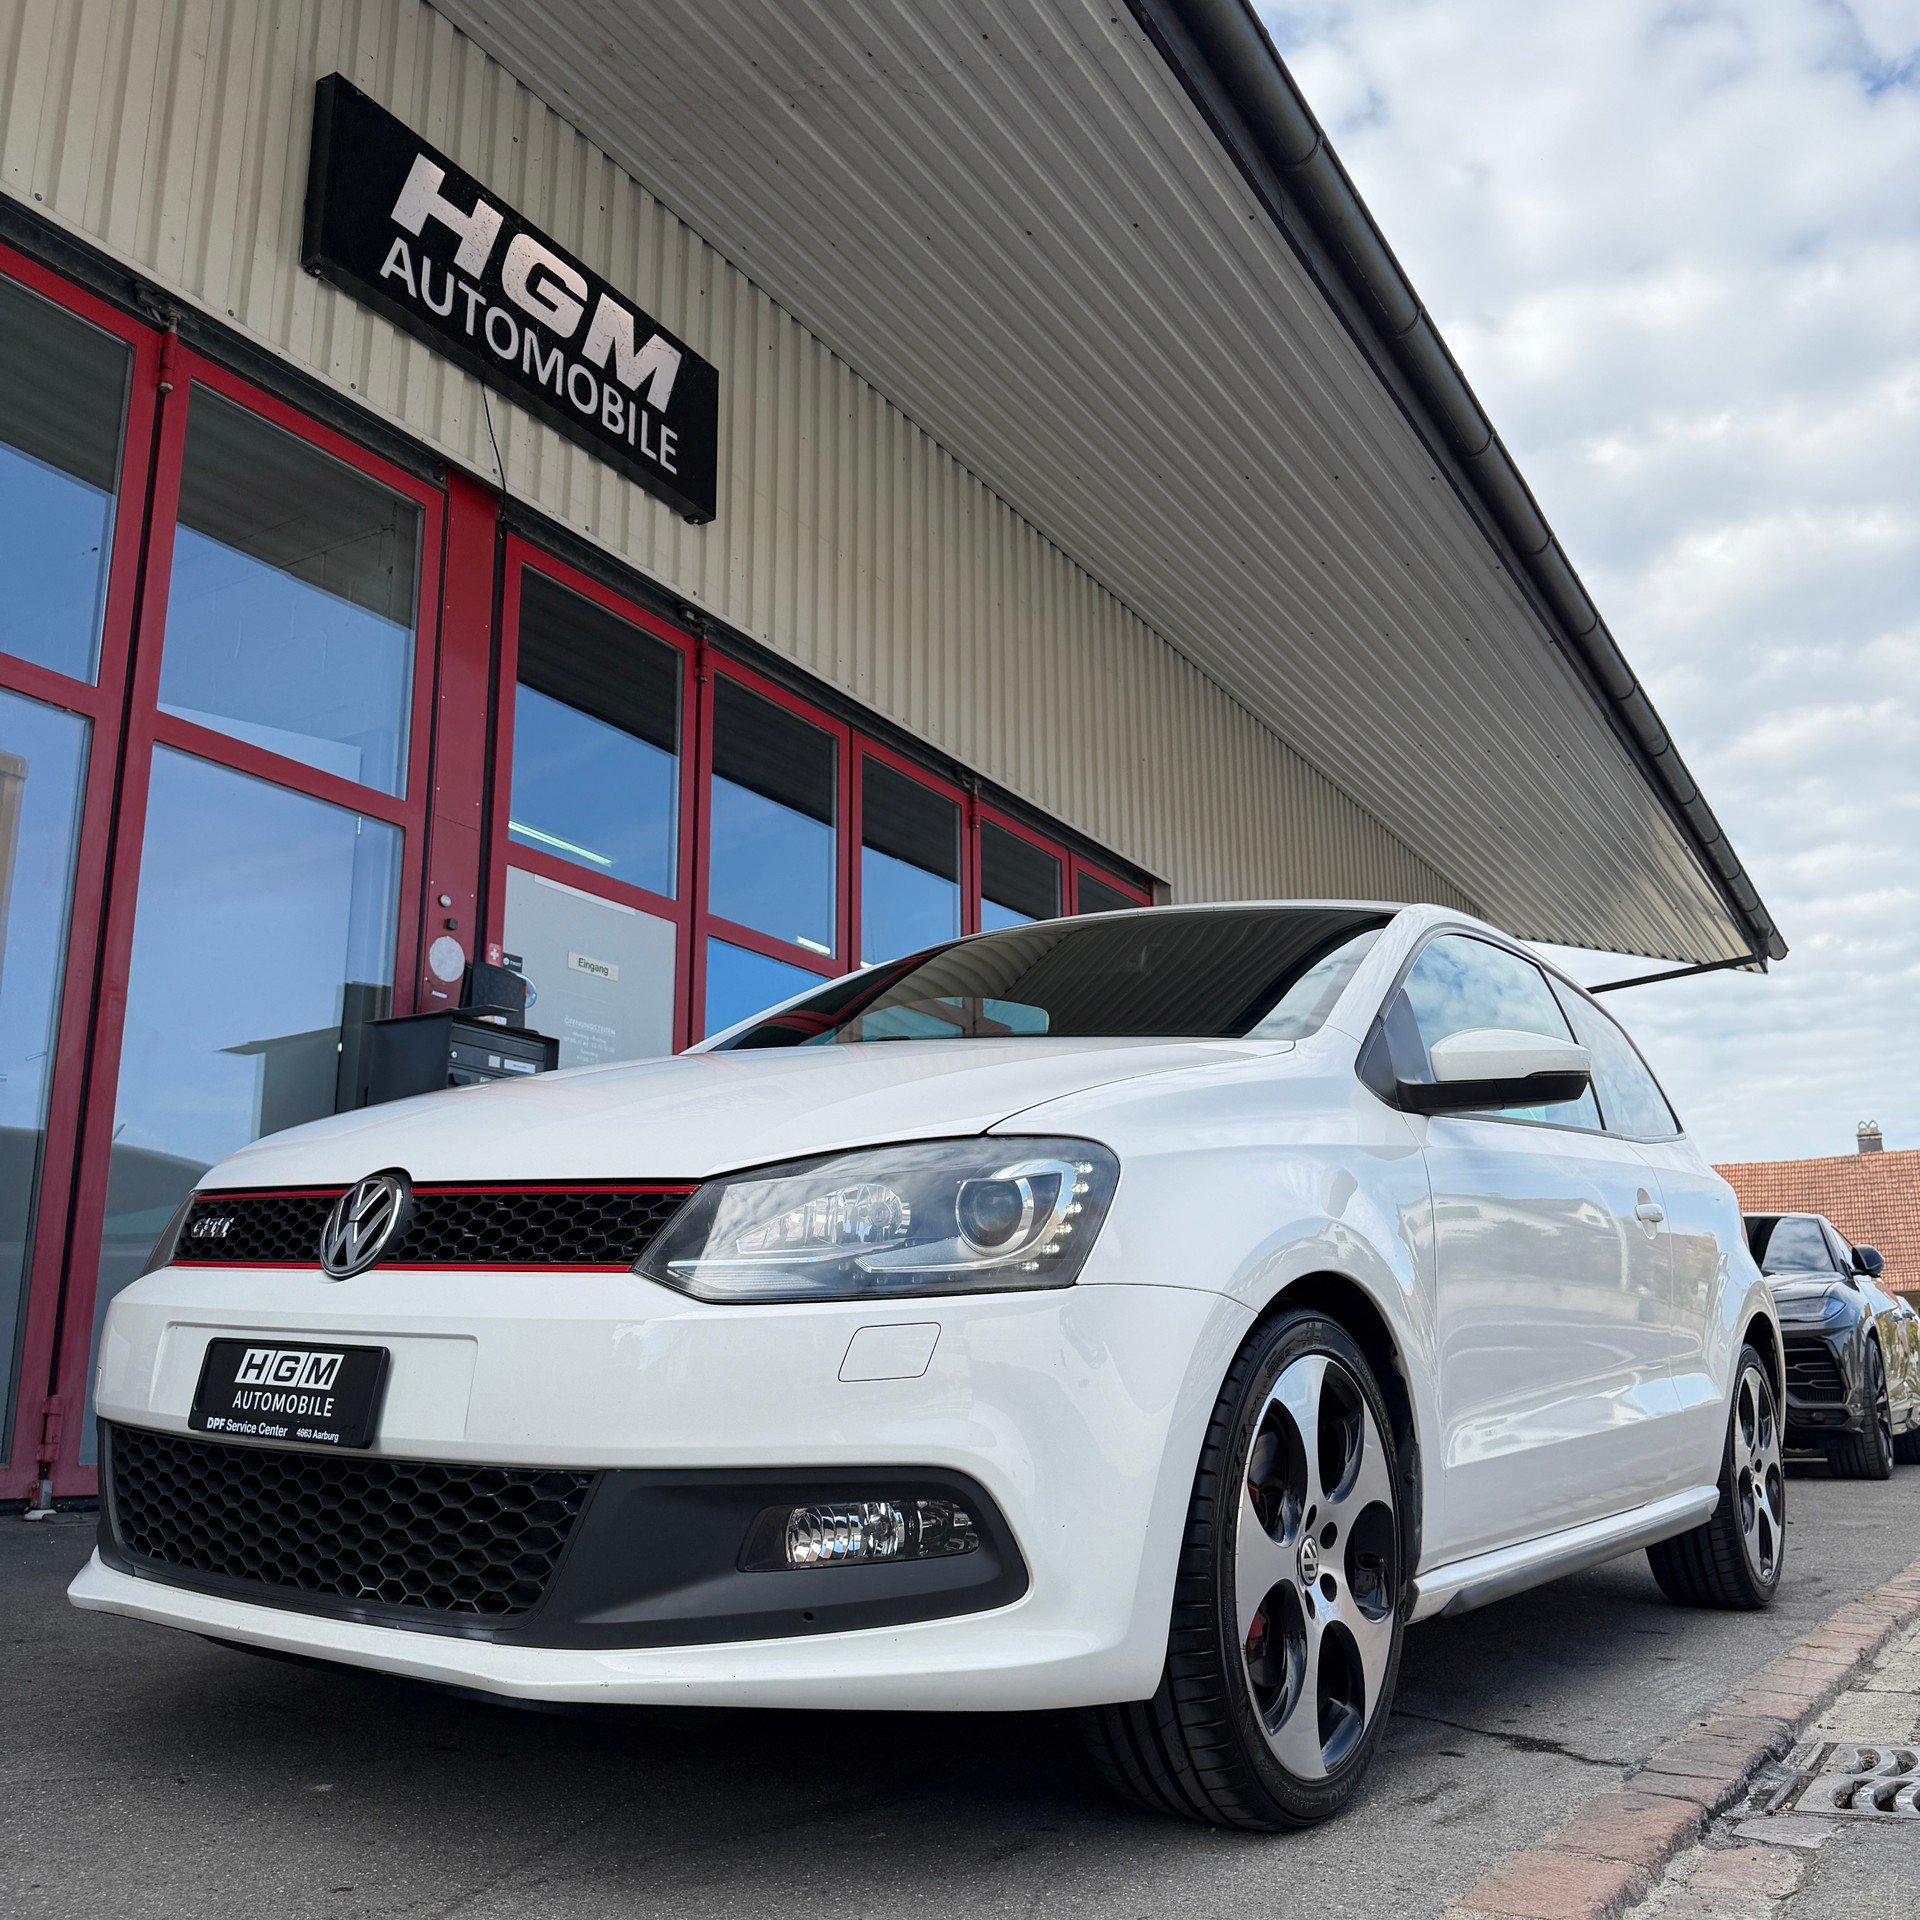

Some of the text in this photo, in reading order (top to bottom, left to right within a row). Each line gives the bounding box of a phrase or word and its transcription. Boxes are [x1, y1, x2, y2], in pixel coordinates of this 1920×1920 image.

[391, 152, 682, 413] HGM
[380, 237, 679, 475] AUTOMOBILE
[578, 957, 609, 977] Eingang
[236, 1350, 342, 1389] HGM
[232, 1390, 335, 1417] AUTOMOBILE
[206, 1416, 288, 1437] DPF Service Center
[312, 1429, 340, 1443] Aarburg
